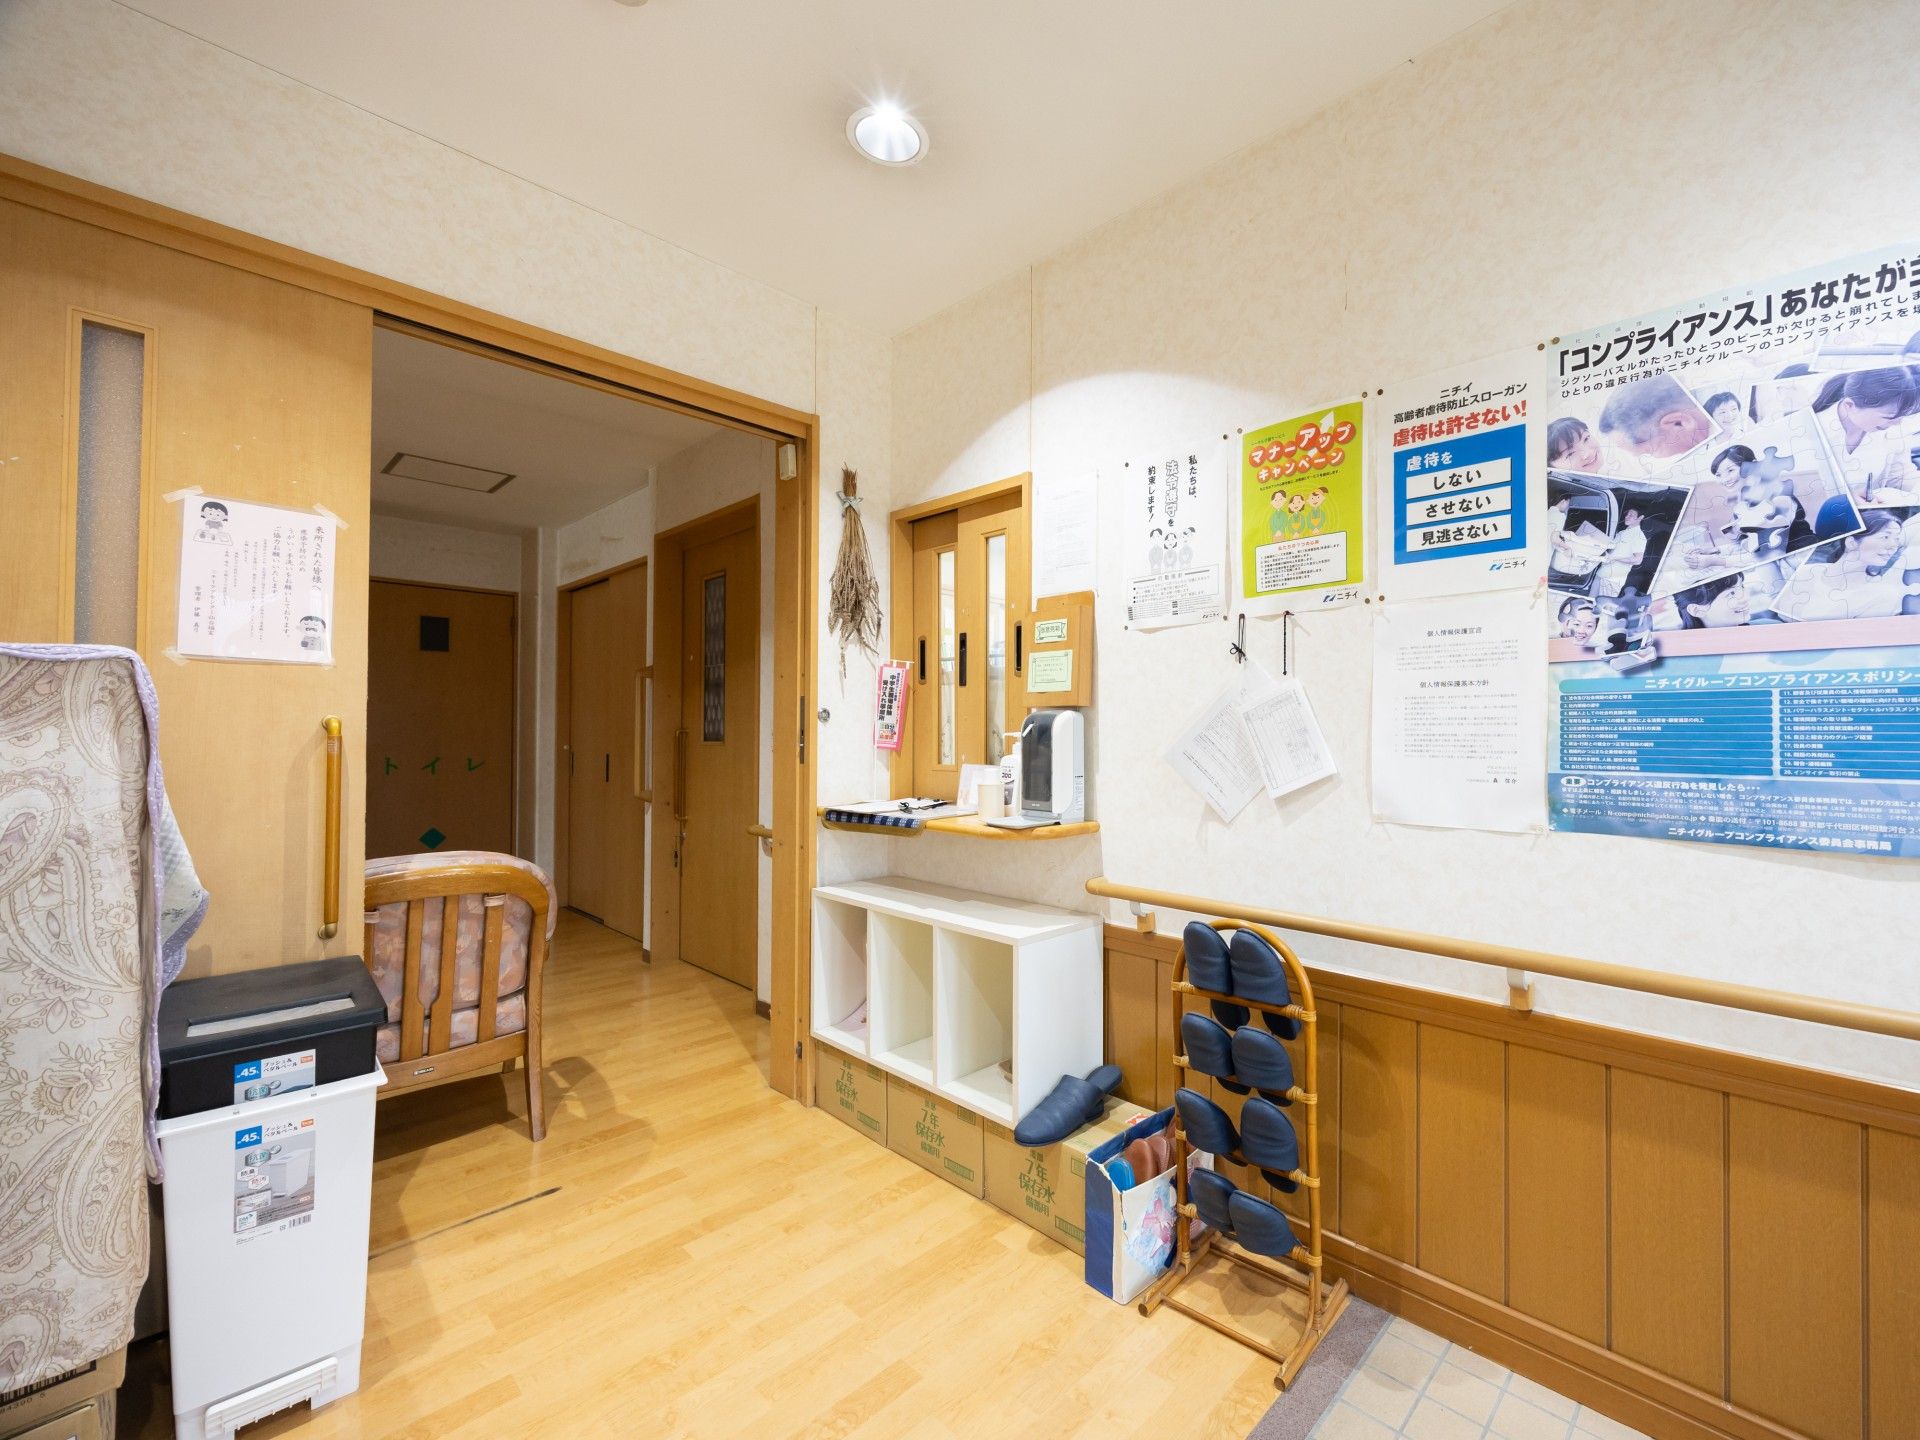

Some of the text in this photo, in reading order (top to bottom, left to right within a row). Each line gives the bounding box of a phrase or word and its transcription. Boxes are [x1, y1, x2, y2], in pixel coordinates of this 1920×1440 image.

[1440, 382, 1473, 399] ニチイ
[1393, 383, 1527, 424] 高齢者虐待防止スローガン
[1251, 423, 1352, 464] マナーアップ
[1258, 451, 1343, 481] キャンペーン
[1406, 451, 1453, 472] 虐待を
[1433, 469, 1482, 490] しない
[1426, 495, 1491, 518] させない
[1421, 522, 1498, 546] 見逃さない
[1503, 559, 1527, 569] ニチイ
[1337, 591, 1359, 600] ニチイ
[384, 756, 485, 776] トイレ
[921, 1108, 940, 1129] 7年
[915, 1120, 945, 1148] 保存水
[1025, 1158, 1048, 1182] 7年
[1018, 1172, 1056, 1205] 保存水
